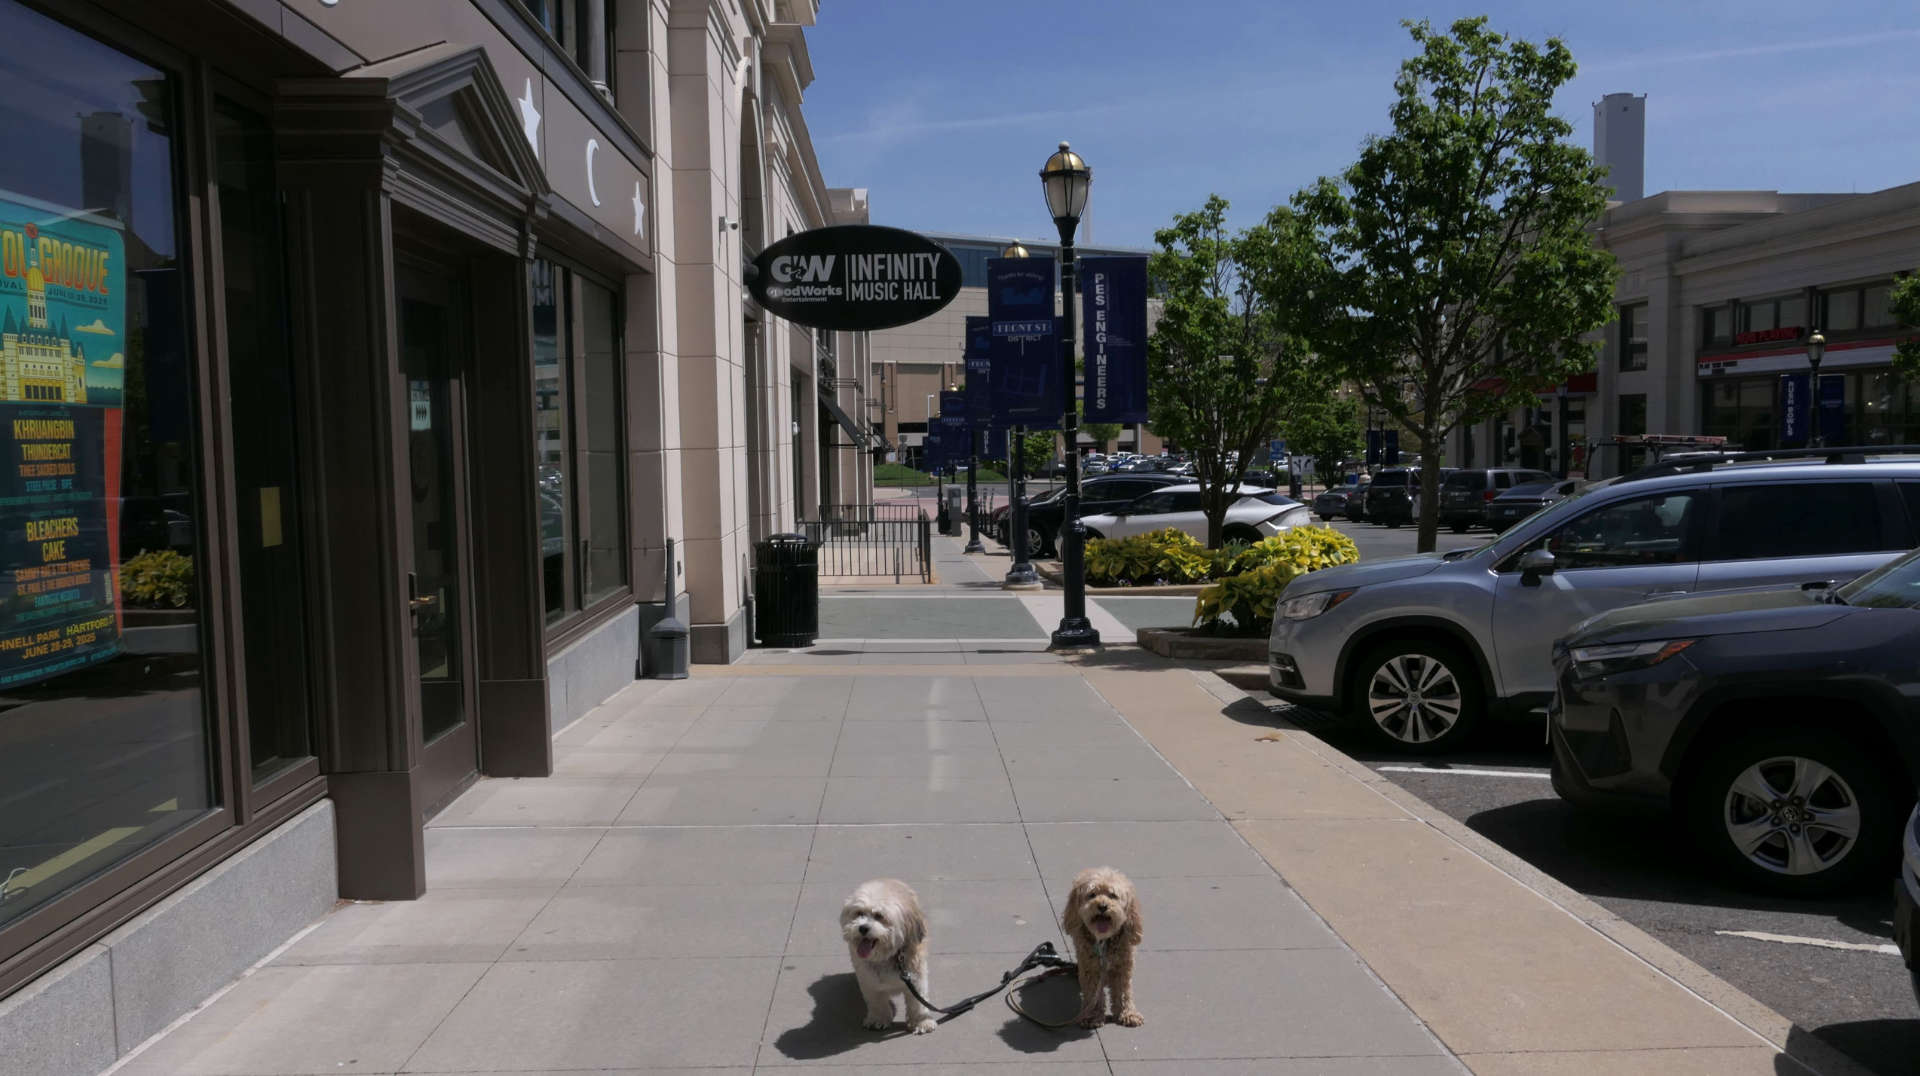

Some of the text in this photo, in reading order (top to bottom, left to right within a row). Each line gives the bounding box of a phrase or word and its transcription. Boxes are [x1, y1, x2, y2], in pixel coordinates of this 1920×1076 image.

[0, 229, 109, 295] OL GROOVE
[852, 253, 942, 282] INFINITY
[852, 281, 942, 302] MUSIC HALL
[1095, 273, 1107, 410] PES ENGINEERS
[13, 419, 75, 440] KHRUANGBIN
[21, 443, 72, 462] THUNDERCAT
[26, 516, 80, 542] BLEACHERS
[42, 539, 66, 562] CAKE
[36, 628, 60, 644] PARK
[22, 643, 48, 661] JUNE
